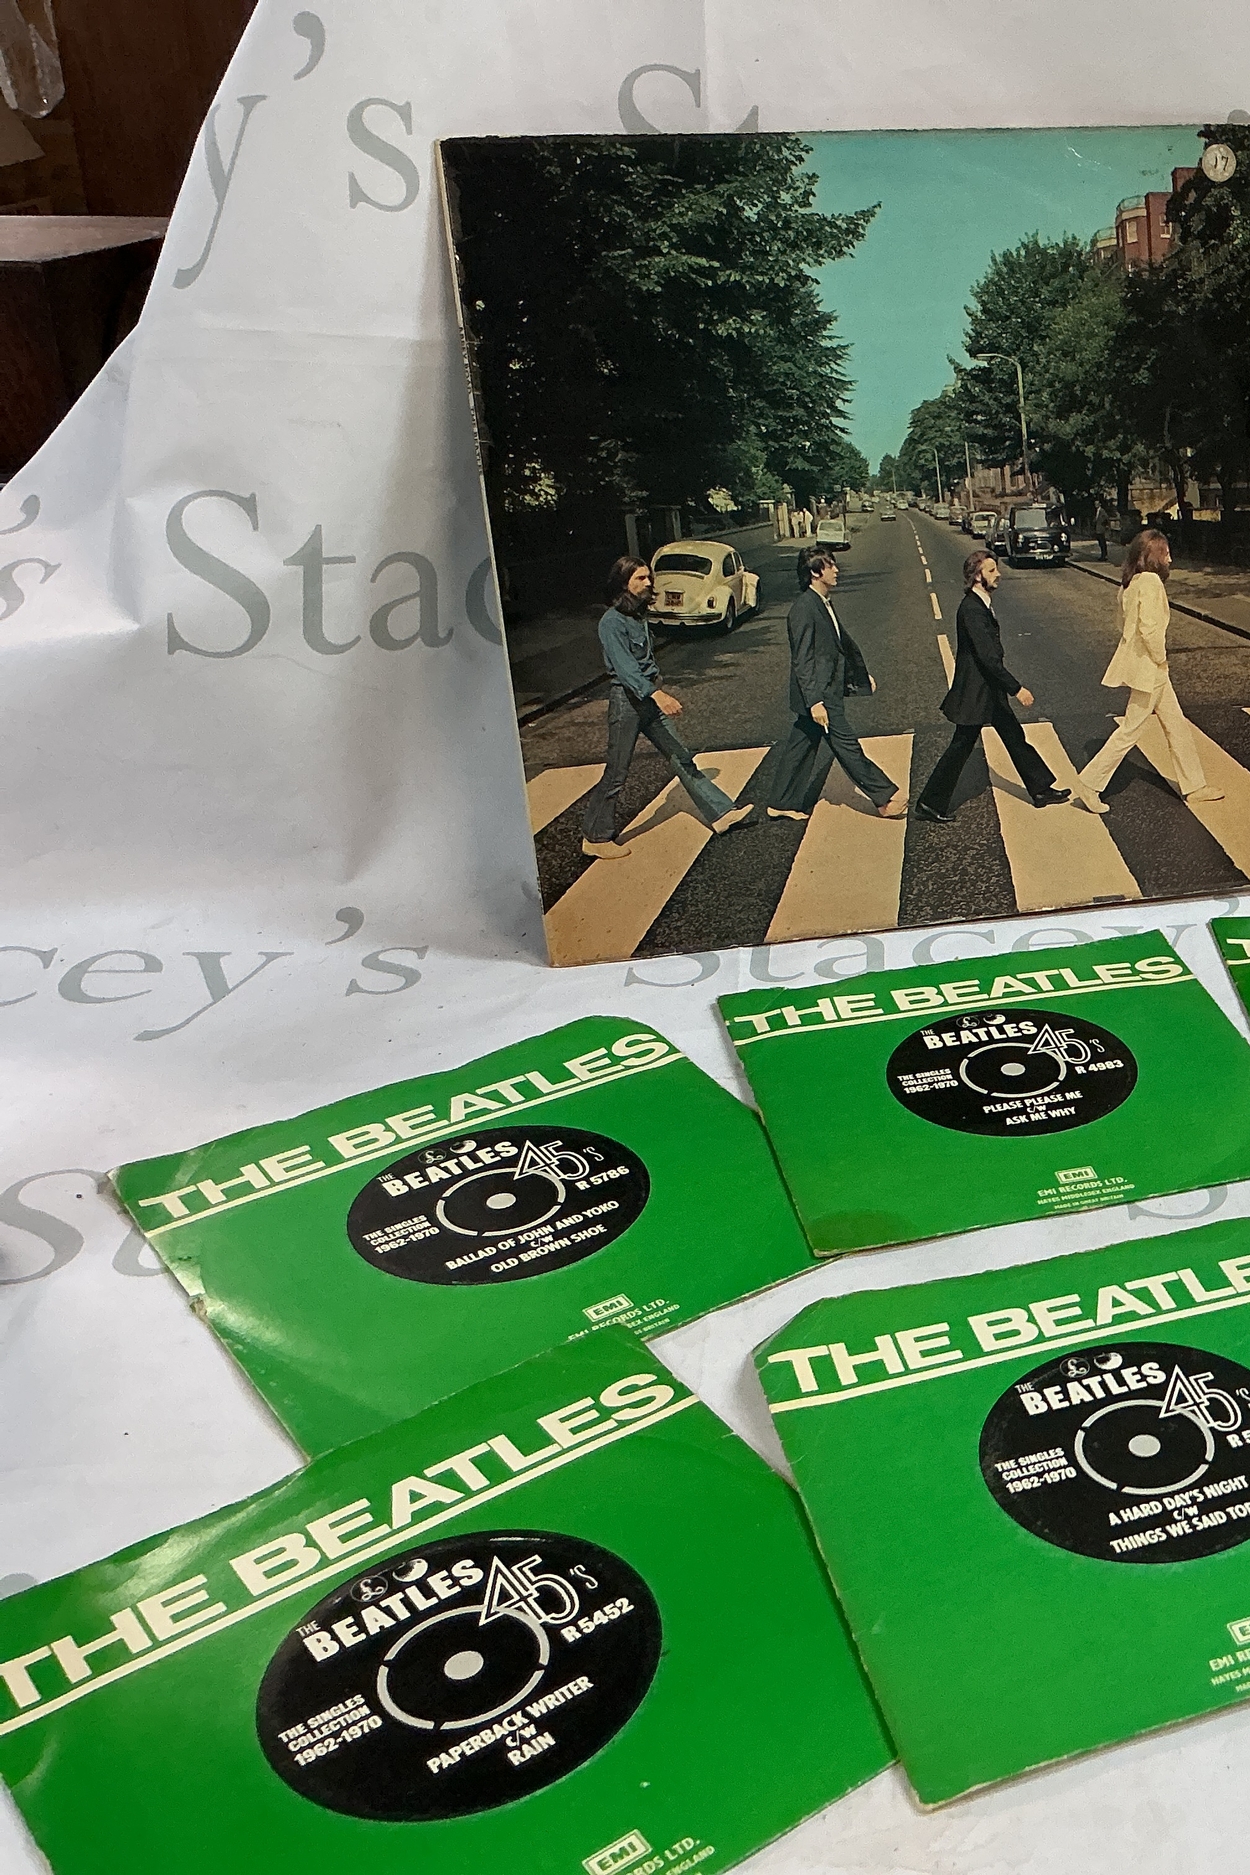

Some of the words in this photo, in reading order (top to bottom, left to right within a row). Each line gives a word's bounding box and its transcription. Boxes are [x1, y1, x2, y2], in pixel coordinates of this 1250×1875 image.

[1214, 156, 1228, 171] 17
[735, 993, 884, 1034] THE
[890, 956, 1185, 1012] BEATLES
[920, 1028, 934, 1036] THE
[923, 1021, 1038, 1050] BEATLES
[1075, 1065, 1087, 1075] R
[1089, 1060, 1124, 1072] 4983
[982, 1100, 1023, 1114] PLEASE
[1024, 1093, 1064, 1107] PLEASE
[1065, 1090, 1083, 1100] ME
[1006, 1114, 1029, 1126] ASK
[1031, 1110, 1048, 1121] ME
[1048, 1106, 1077, 1118] WHY
[138, 1143, 329, 1219] THE
[326, 1032, 671, 1163] BEATLES
[377, 1172, 395, 1183] THE
[381, 1140, 519, 1198] BEATLES
[574, 1181, 591, 1191] R
[592, 1166, 630, 1186] 5786
[362, 1231, 390, 1241] THE
[390, 1215, 427, 1234] SINGLES
[370, 1222, 431, 1246] COLLECTION
[374, 1227, 440, 1254] 1962-1970
[445, 1246, 497, 1270] BALLAD
[498, 1239, 516, 1252] OF
[518, 1226, 554, 1245] JOHN
[555, 1214, 583, 1231] AND
[581, 1200, 619, 1222] YOKO
[490, 1257, 519, 1273] OLD
[519, 1237, 571, 1262] BROWN
[572, 1224, 607, 1244] SHOE
[768, 1322, 964, 1394] THE
[1015, 1382, 1034, 1394] THE
[1020, 1361, 1167, 1416] BEATLES
[1226, 1434, 1243, 1449] R
[995, 1459, 1018, 1473] THE
[1018, 1448, 1065, 1466] SINGLES
[1002, 1457, 1068, 1481] COLLECTION
[1005, 1466, 1077, 1495] 1962-1970
[1108, 1513, 1123, 1527] A
[1120, 1502, 1162, 1523] HARD
[1163, 1488, 1204, 1511] DAY'S
[1204, 1475, 1249, 1500] NIGHT
[0, 1574, 228, 1709] THE
[228, 1373, 676, 1599] BEATLES
[1110, 1528, 1168, 1554] THINGS
[1167, 1520, 1193, 1538] WE
[1195, 1509, 1227, 1531] SAID
[302, 1559, 485, 1662] BEATLES
[560, 1627, 580, 1644] R
[579, 1597, 635, 1637] 5452
[296, 1619, 321, 1639] THE
[1209, 1654, 1235, 1671] EMI
[278, 1724, 309, 1744] THE
[306, 1694, 365, 1730] SINGLES
[287, 1704, 371, 1753] COLLECTION
[426, 1710, 528, 1775] PAPERBACK
[525, 1675, 594, 1716] WRITER
[293, 1715, 383, 1766] 1962-1970
[506, 1731, 556, 1767] RAIN
